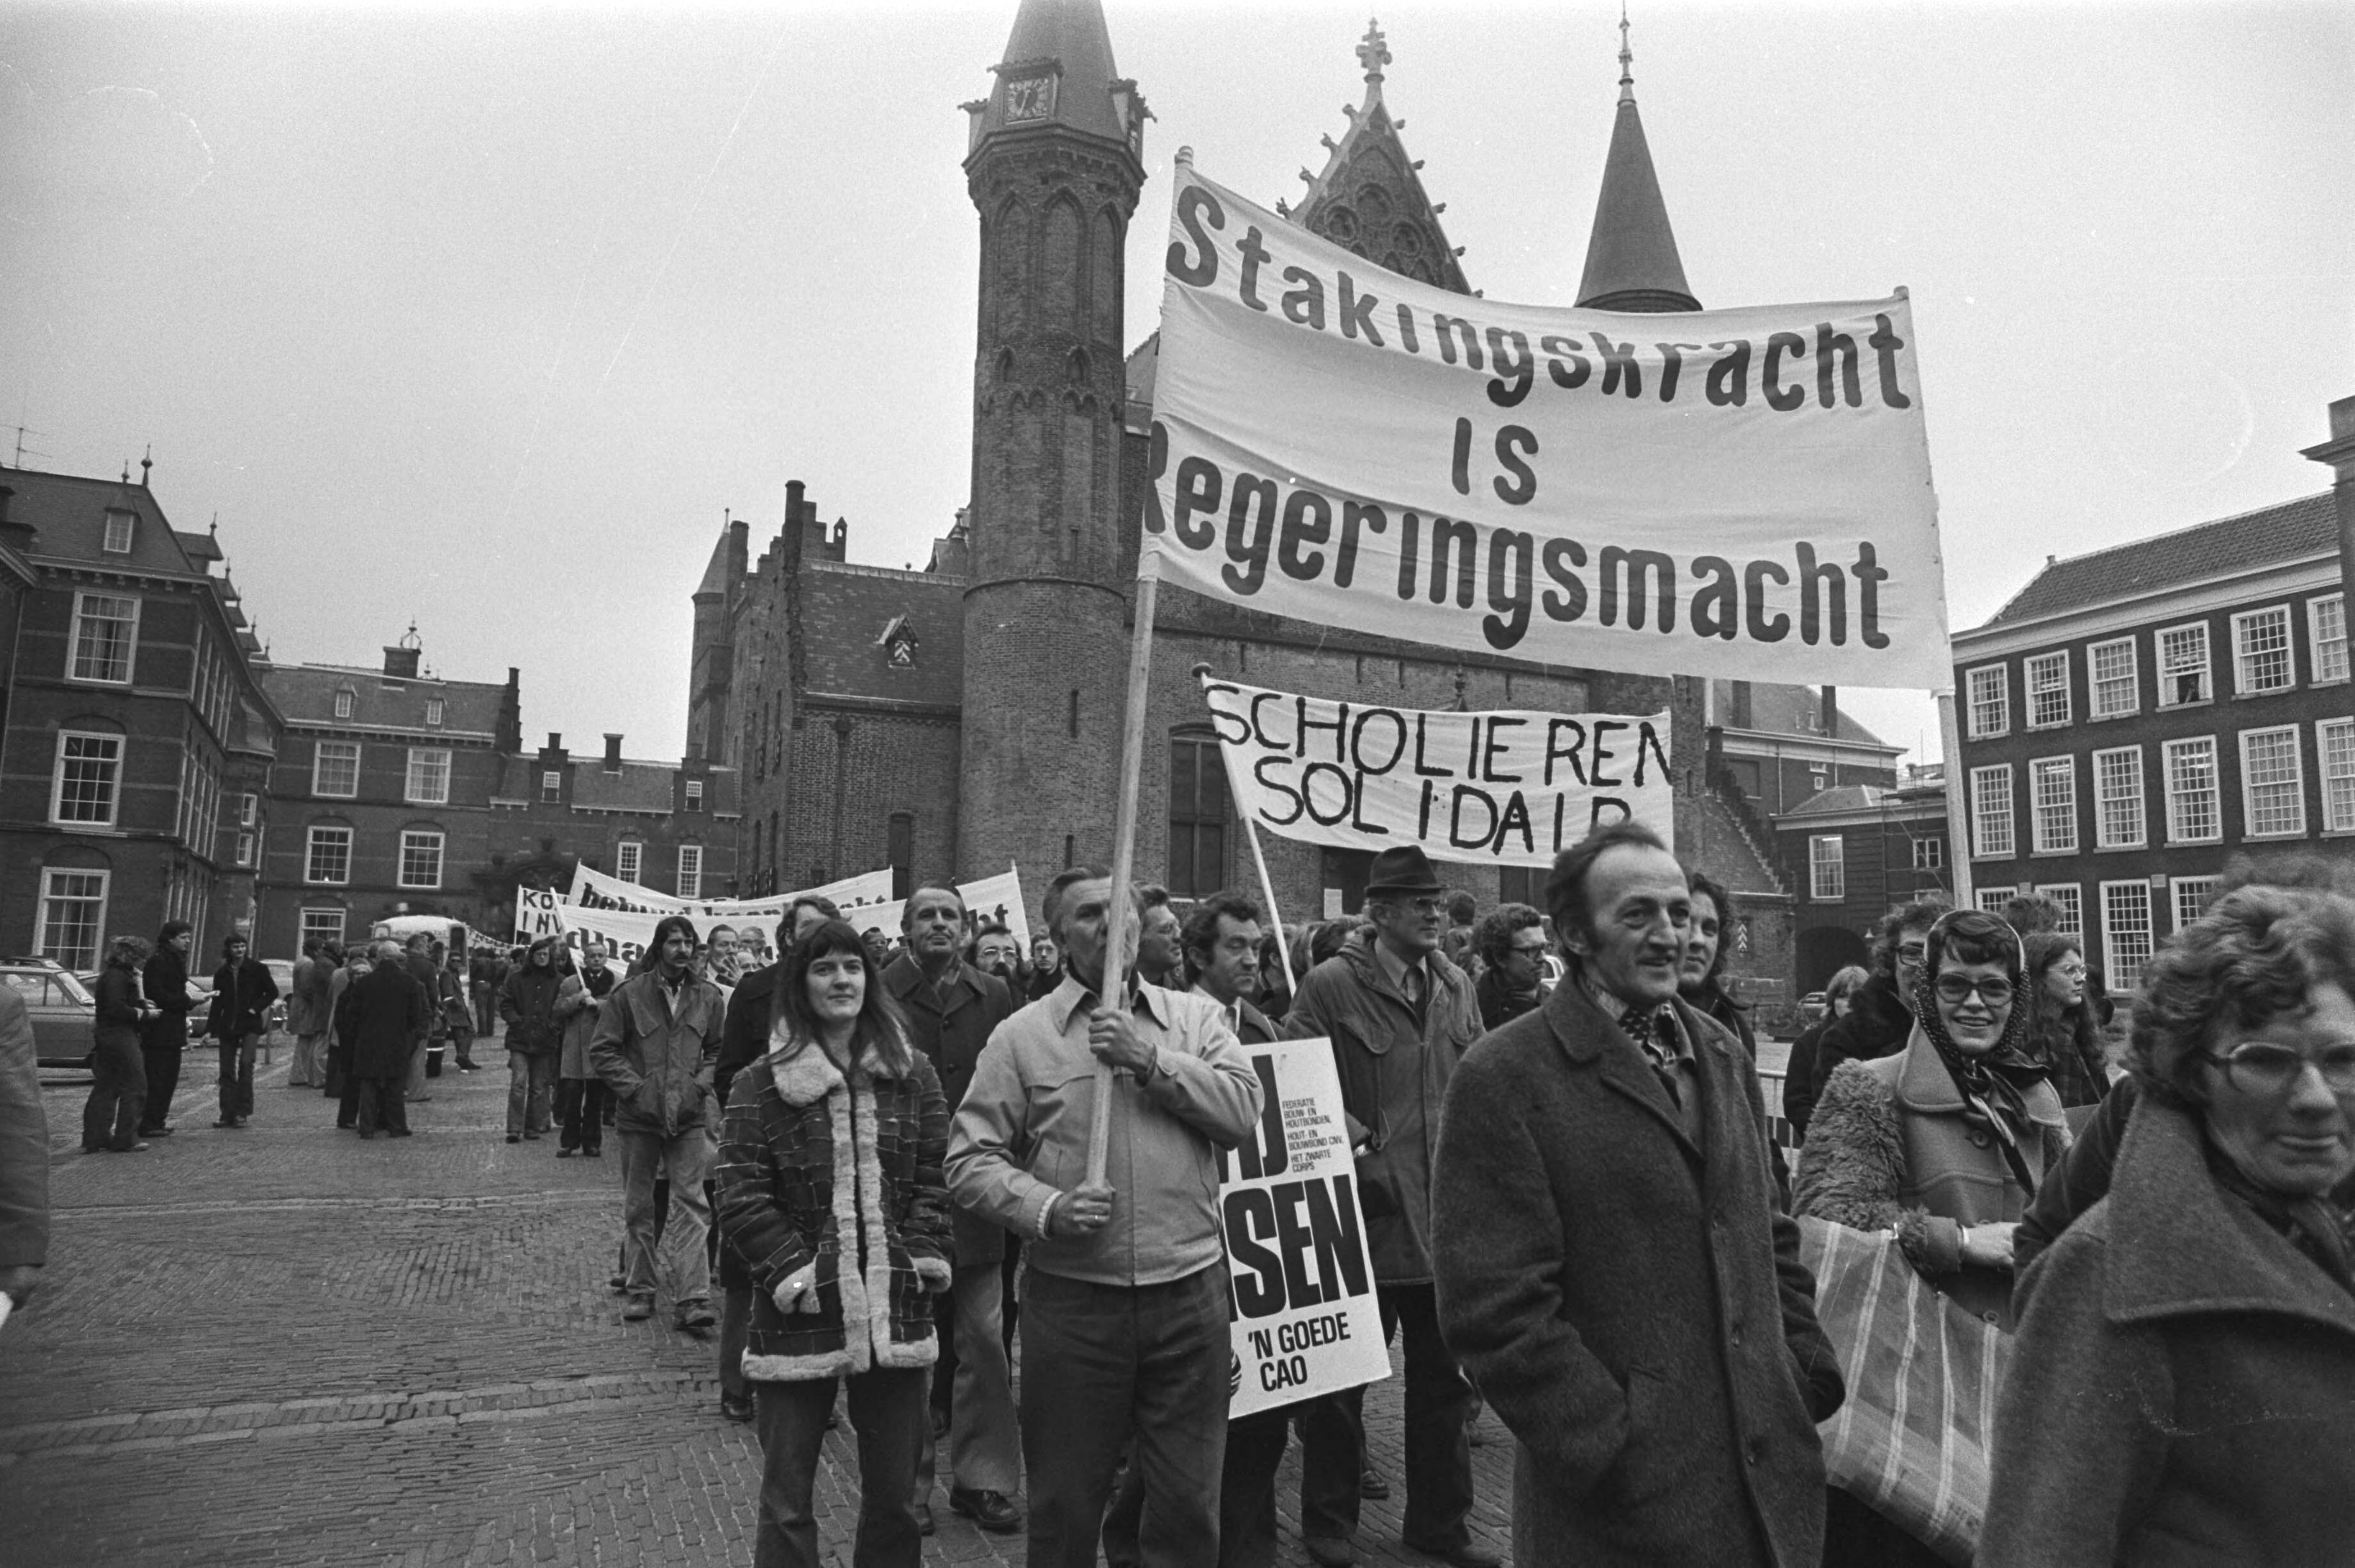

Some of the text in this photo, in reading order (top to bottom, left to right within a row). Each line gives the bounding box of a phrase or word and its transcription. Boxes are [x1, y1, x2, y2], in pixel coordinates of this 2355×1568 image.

[1167, 184, 1911, 412] Stakingskracht
[1204, 684, 1672, 787] SCHOLIEREN
[1282, 1098, 1315, 1109] FEDERATIE
[1308, 1107, 1317, 1116] EN
[1308, 1129, 1318, 1138] EN
[1288, 1138, 1327, 1150] BOUWBOND
[1291, 1149, 1331, 1163] HET ZWARTE
[1292, 1161, 1315, 1173] CORPS
[1223, 1173, 1370, 1323] SEN
[1278, 1312, 1351, 1353] GOEDE
[1260, 1355, 1308, 1392] CAO
